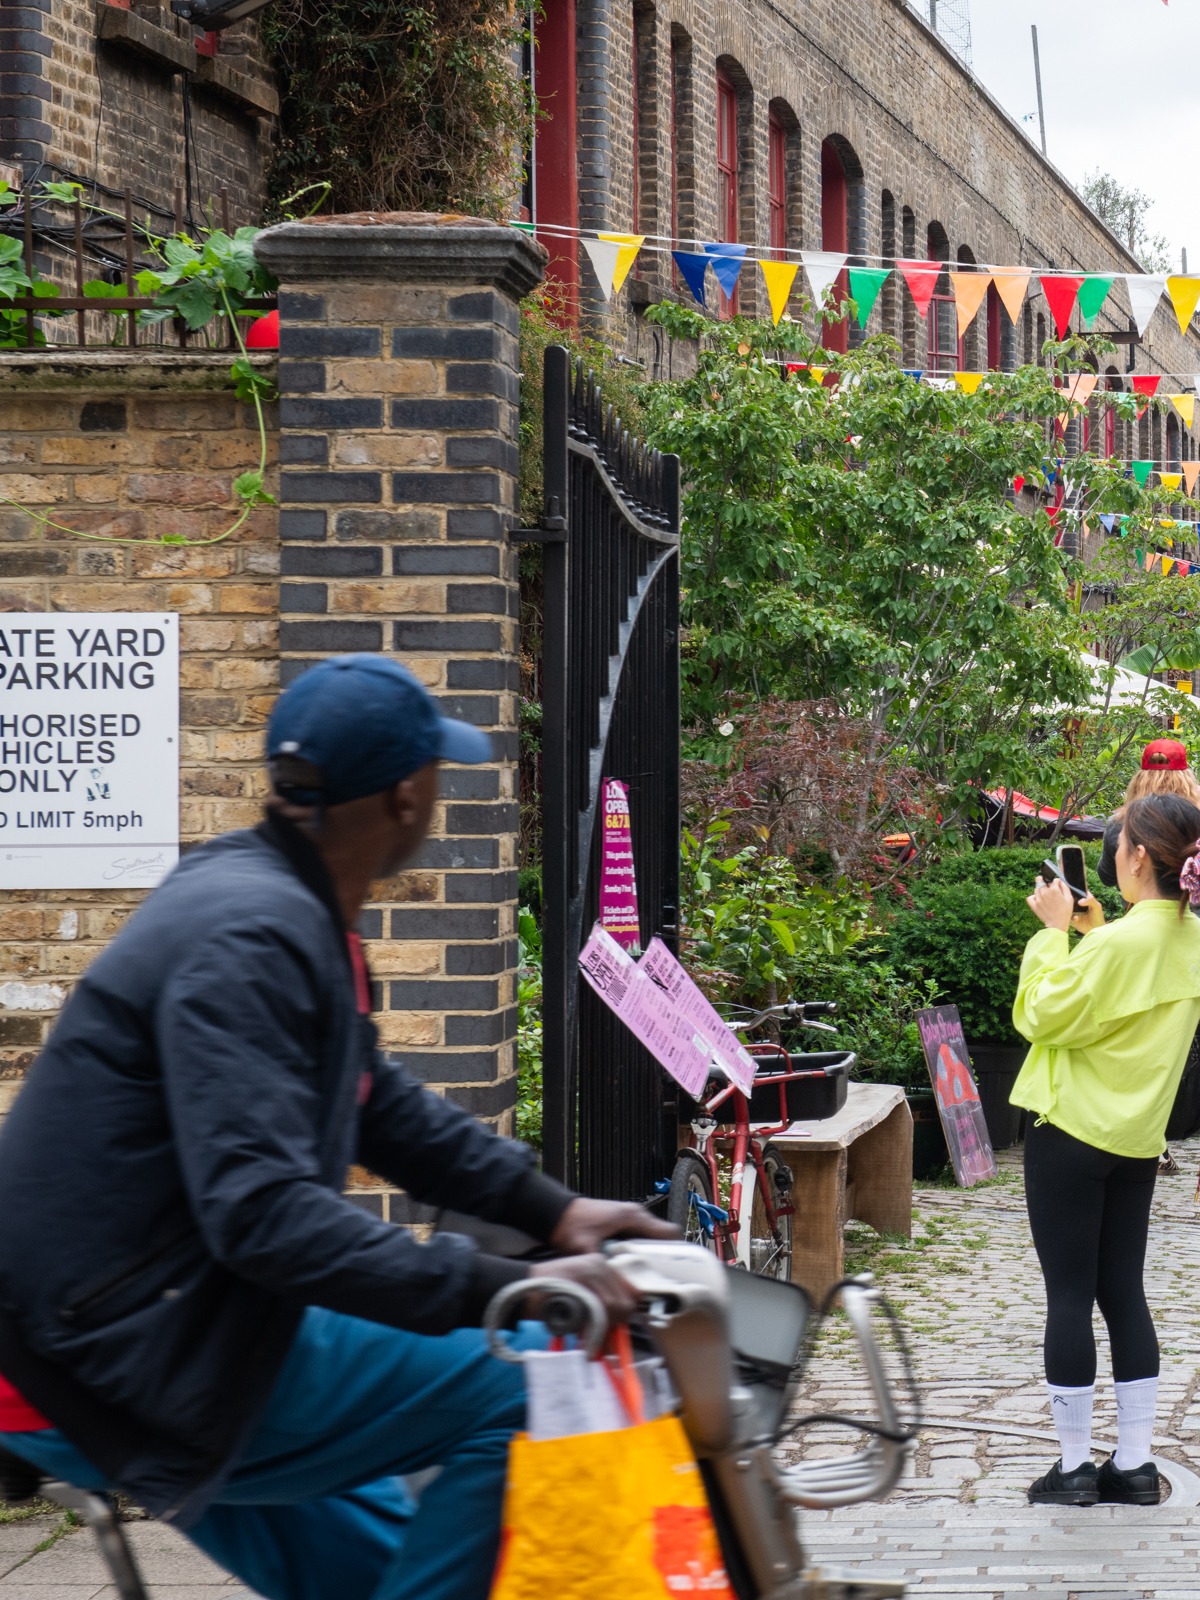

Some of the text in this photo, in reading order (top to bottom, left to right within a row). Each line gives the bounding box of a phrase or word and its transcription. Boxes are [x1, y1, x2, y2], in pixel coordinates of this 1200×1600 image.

[67, 628, 165, 657] YARD
[0, 714, 141, 738] HORISED
[2, 740, 116, 764] HICLES
[0, 769, 79, 793] ONLY
[16, 811, 75, 828] LIMIT
[83, 810, 143, 832] 5mph
